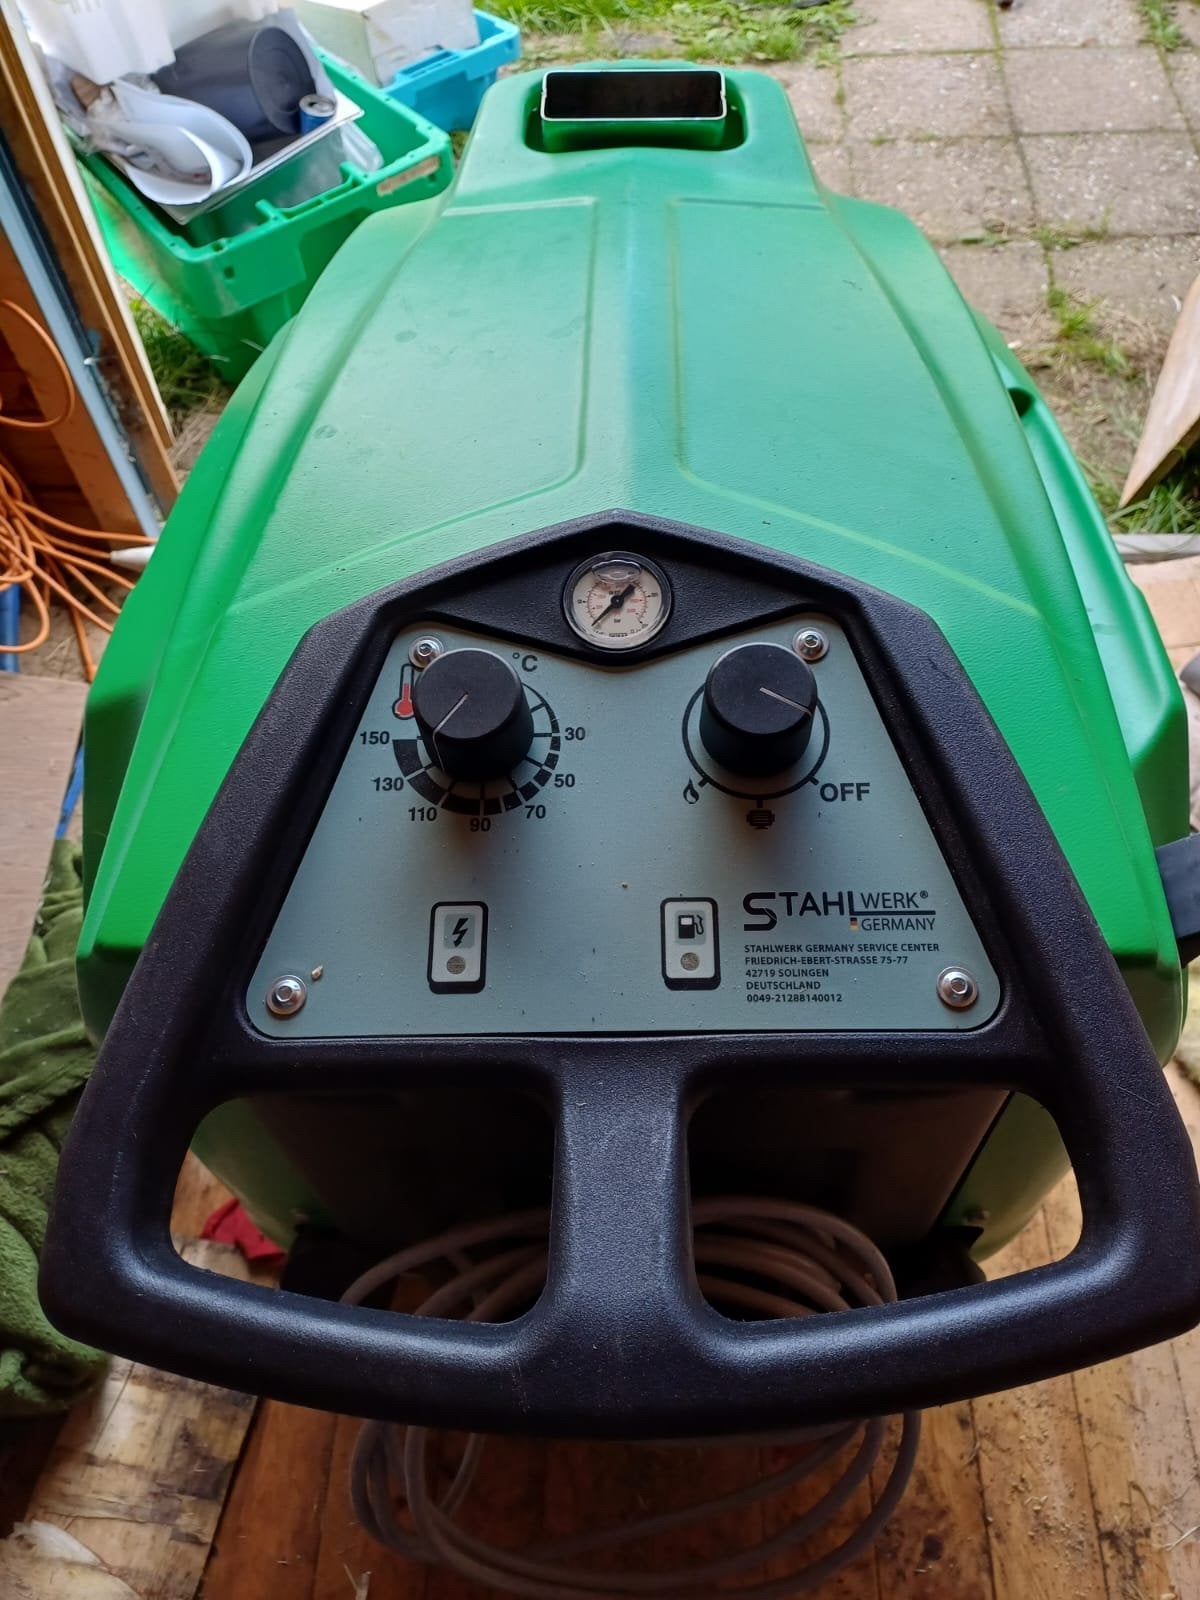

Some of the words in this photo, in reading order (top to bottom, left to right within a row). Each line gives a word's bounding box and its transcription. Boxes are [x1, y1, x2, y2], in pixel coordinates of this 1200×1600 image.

[360, 731, 390, 745] 150
[564, 727, 586, 741] 30
[373, 777, 404, 791] 130
[554, 774, 576, 788] 50
[819, 782, 870, 802] OFF
[408, 807, 437, 822] 110
[525, 805, 546, 819] 70
[470, 818, 491, 832] 90
[861, 917, 936, 931] GERMANY
[744, 944, 803, 953] STAHLWERK
[805, 944, 854, 953] GERMANY
[857, 943, 898, 952] SERVICE
[901, 943, 939, 952] CENTER
[745, 956, 878, 965] FRIEDRICH-EBERT-STRASSE
[880, 956, 908, 964] 75-77
[745, 969, 776, 977] 42719
[778, 968, 829, 977] SOLINGEN
[746, 981, 821, 990] DEUTSCHLAND
